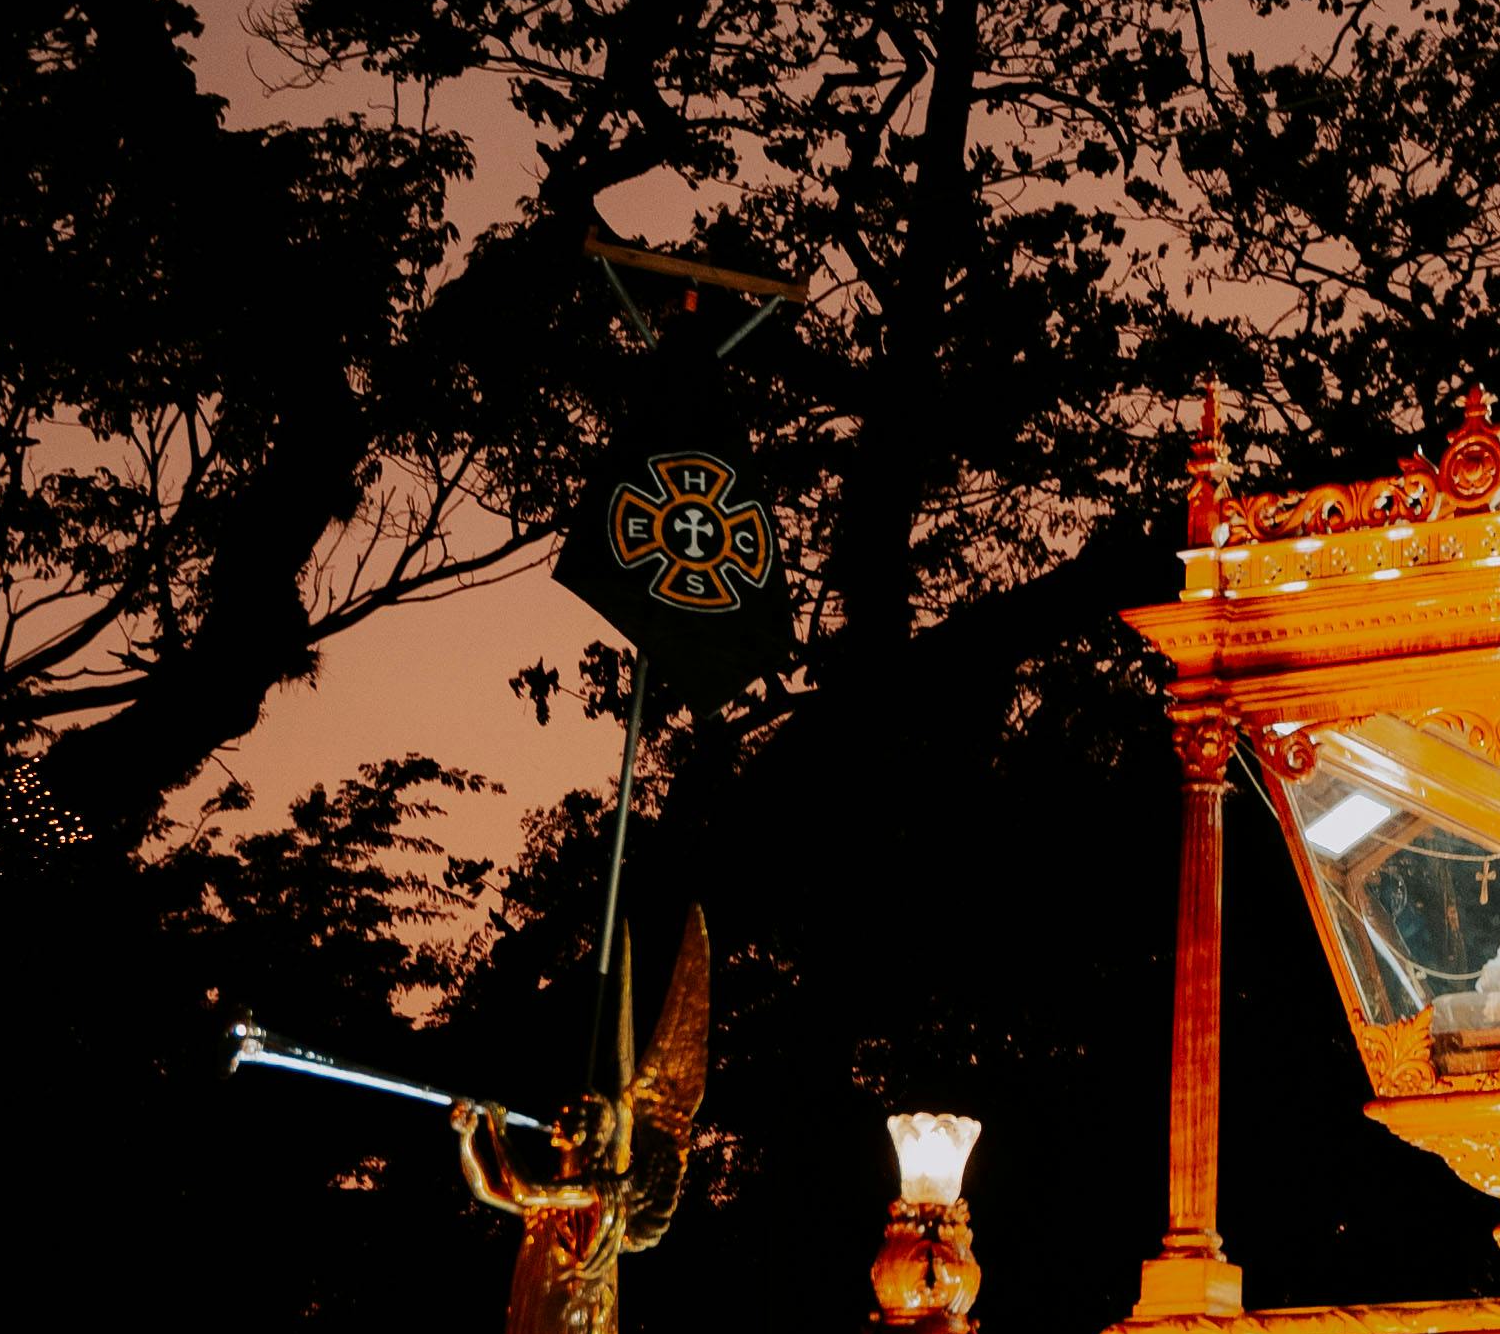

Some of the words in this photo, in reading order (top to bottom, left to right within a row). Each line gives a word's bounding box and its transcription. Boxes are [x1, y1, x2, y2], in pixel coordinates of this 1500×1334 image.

[683, 470, 706, 492] H
[628, 517, 649, 539] E
[734, 531, 755, 554] C
[685, 573, 705, 595] S
